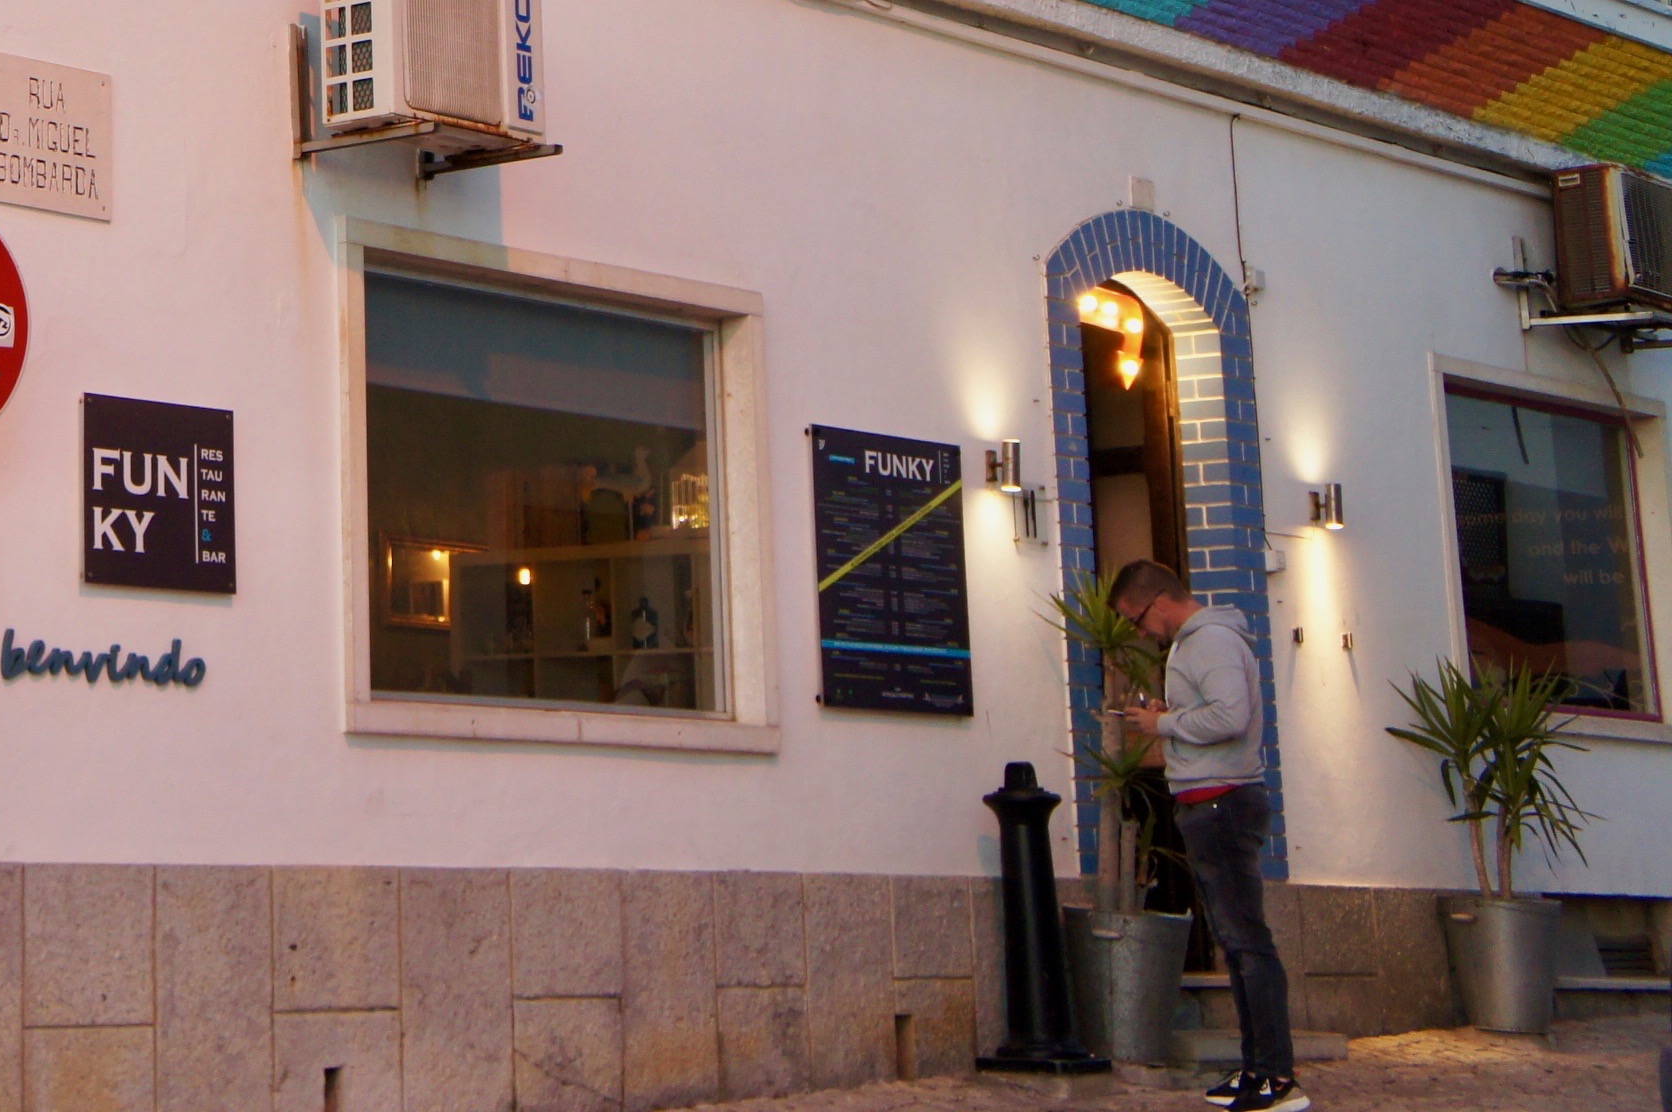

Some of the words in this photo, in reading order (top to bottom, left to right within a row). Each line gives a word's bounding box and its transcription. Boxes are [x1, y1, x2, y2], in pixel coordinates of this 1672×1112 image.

[29, 77, 66, 113] RUA
[28, 117, 96, 158] MIGUEL
[201, 448, 224, 462] RES
[92, 447, 189, 499] FUN
[864, 450, 934, 482] FUNKY
[200, 468, 223, 482] TAU
[201, 489, 226, 502] RAN
[201, 510, 216, 522] TE
[92, 506, 155, 553] KY
[201, 528, 212, 542] &
[202, 551, 226, 563] BAR
[1563, 569, 1594, 585] will
[1599, 569, 1626, 585] be
[0, 627, 207, 687] benvindo
